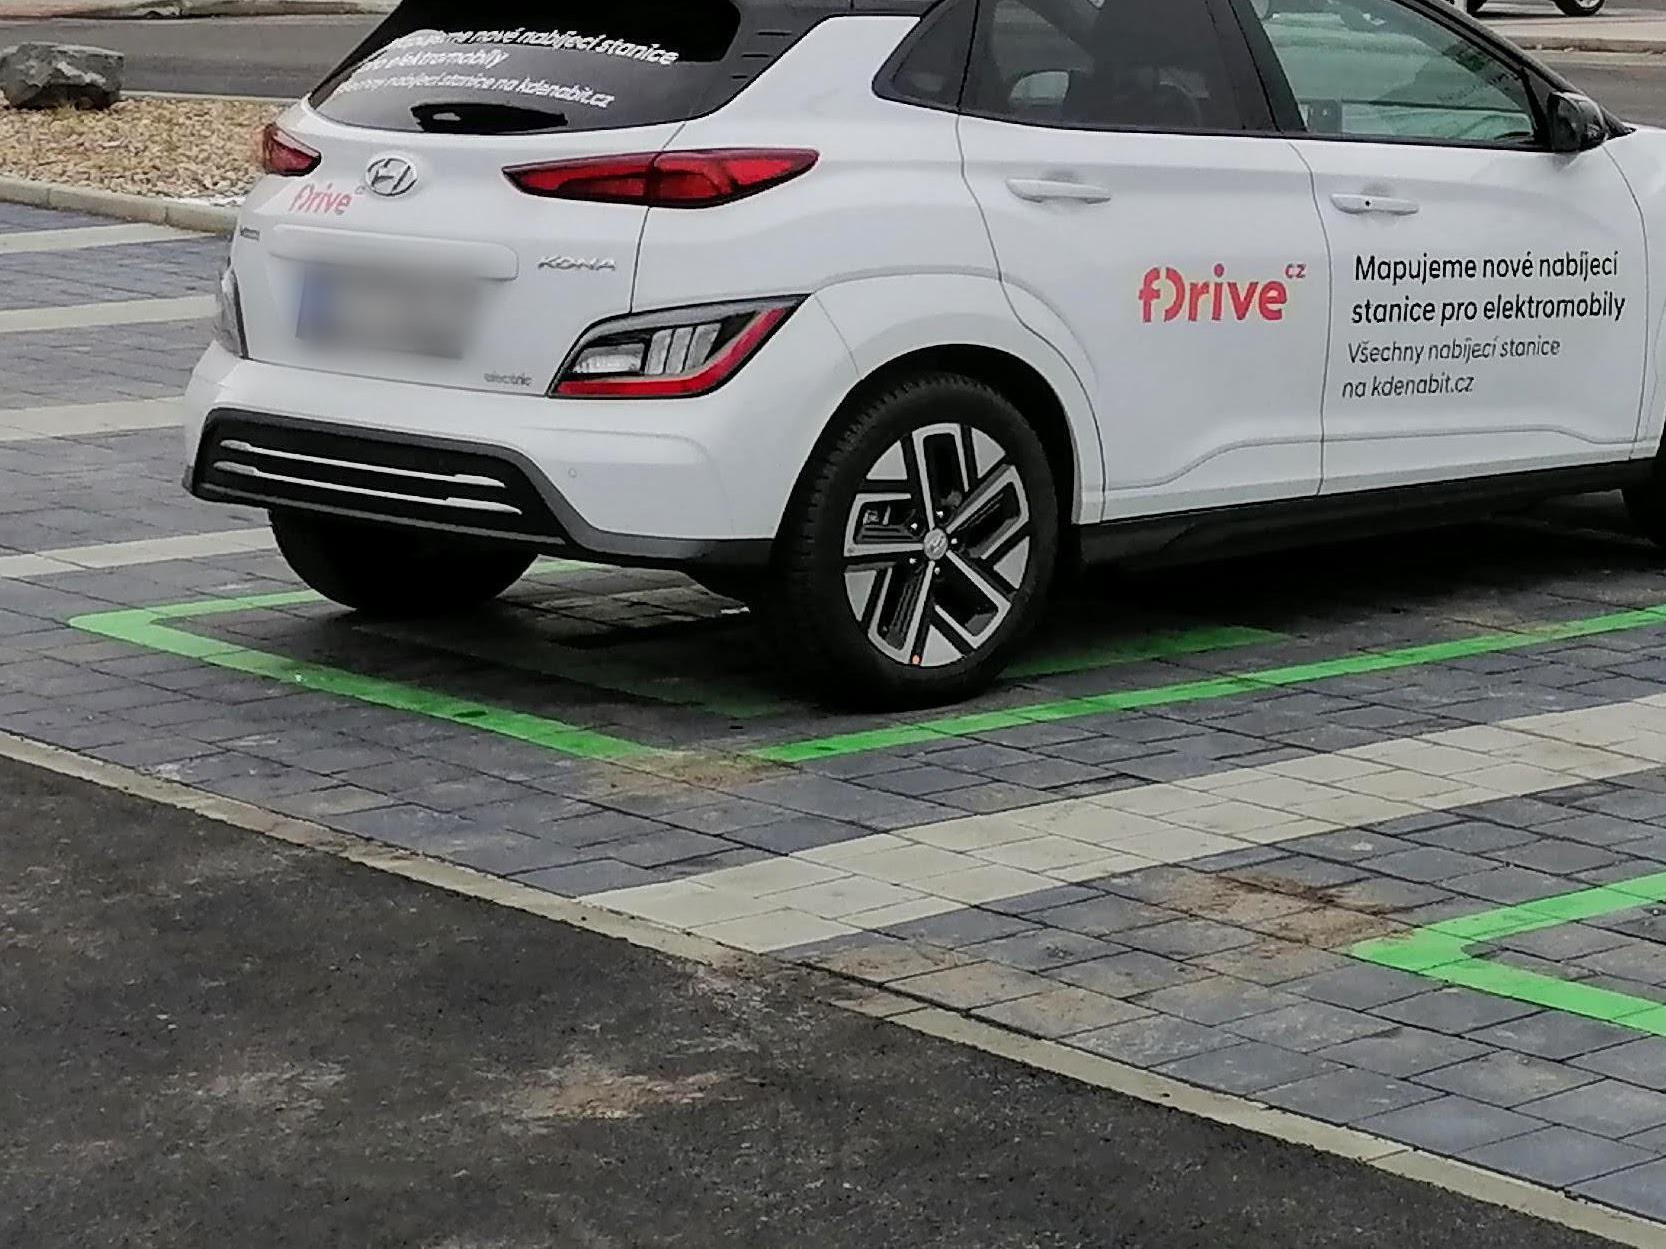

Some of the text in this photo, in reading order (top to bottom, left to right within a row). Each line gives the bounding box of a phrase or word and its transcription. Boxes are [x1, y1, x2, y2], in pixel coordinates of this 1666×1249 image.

[595, 34, 680, 66] stanice
[537, 255, 617, 271] KONA
[1355, 250, 1619, 286] Mapujeme nové nabíjecí
[1351, 290, 1626, 327] stanice pro elektromobily
[1348, 334, 1561, 365] Všechny nabíjecí stanice
[1342, 371, 1475, 398] na kdenabit.cz
